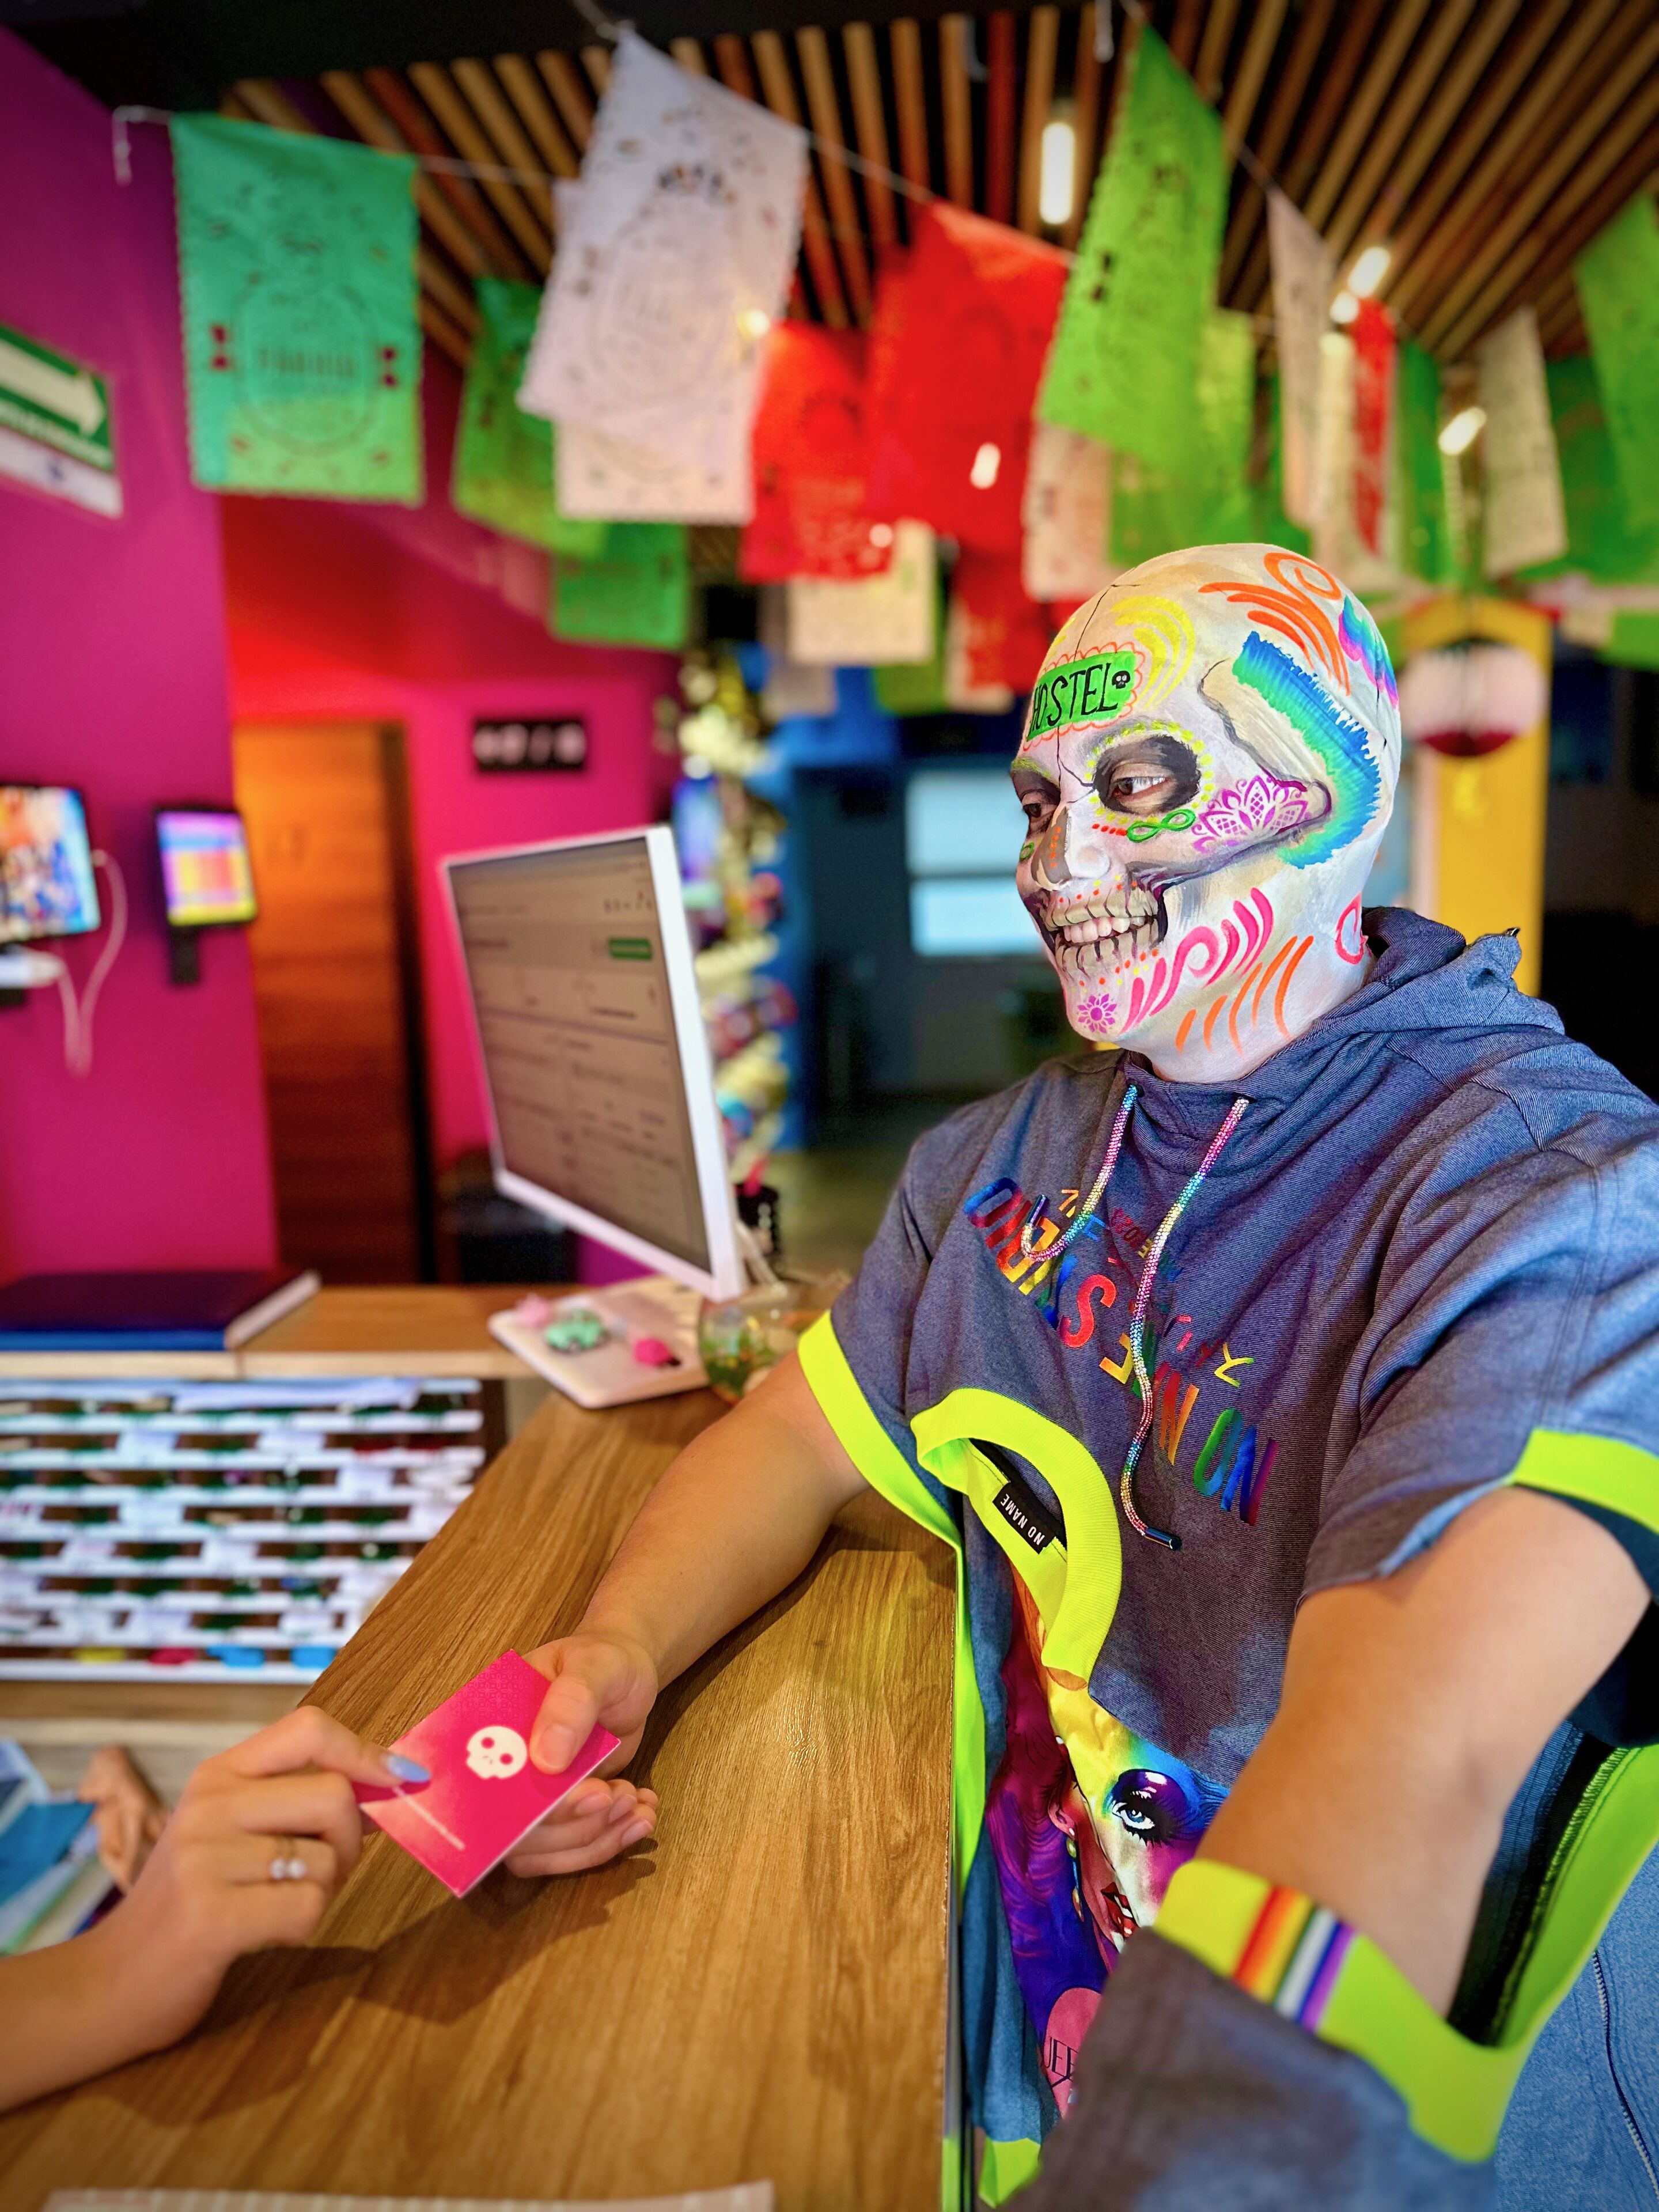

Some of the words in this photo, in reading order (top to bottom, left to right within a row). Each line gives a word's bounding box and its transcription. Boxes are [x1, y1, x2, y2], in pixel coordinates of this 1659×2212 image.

[1028, 662, 1118, 735] HOSTEL
[1099, 1323, 1199, 1465] NE
[1194, 1408, 1279, 1526] NO
[1000, 1493, 1028, 1529] NAME
[1028, 1525, 1046, 1546] NO
